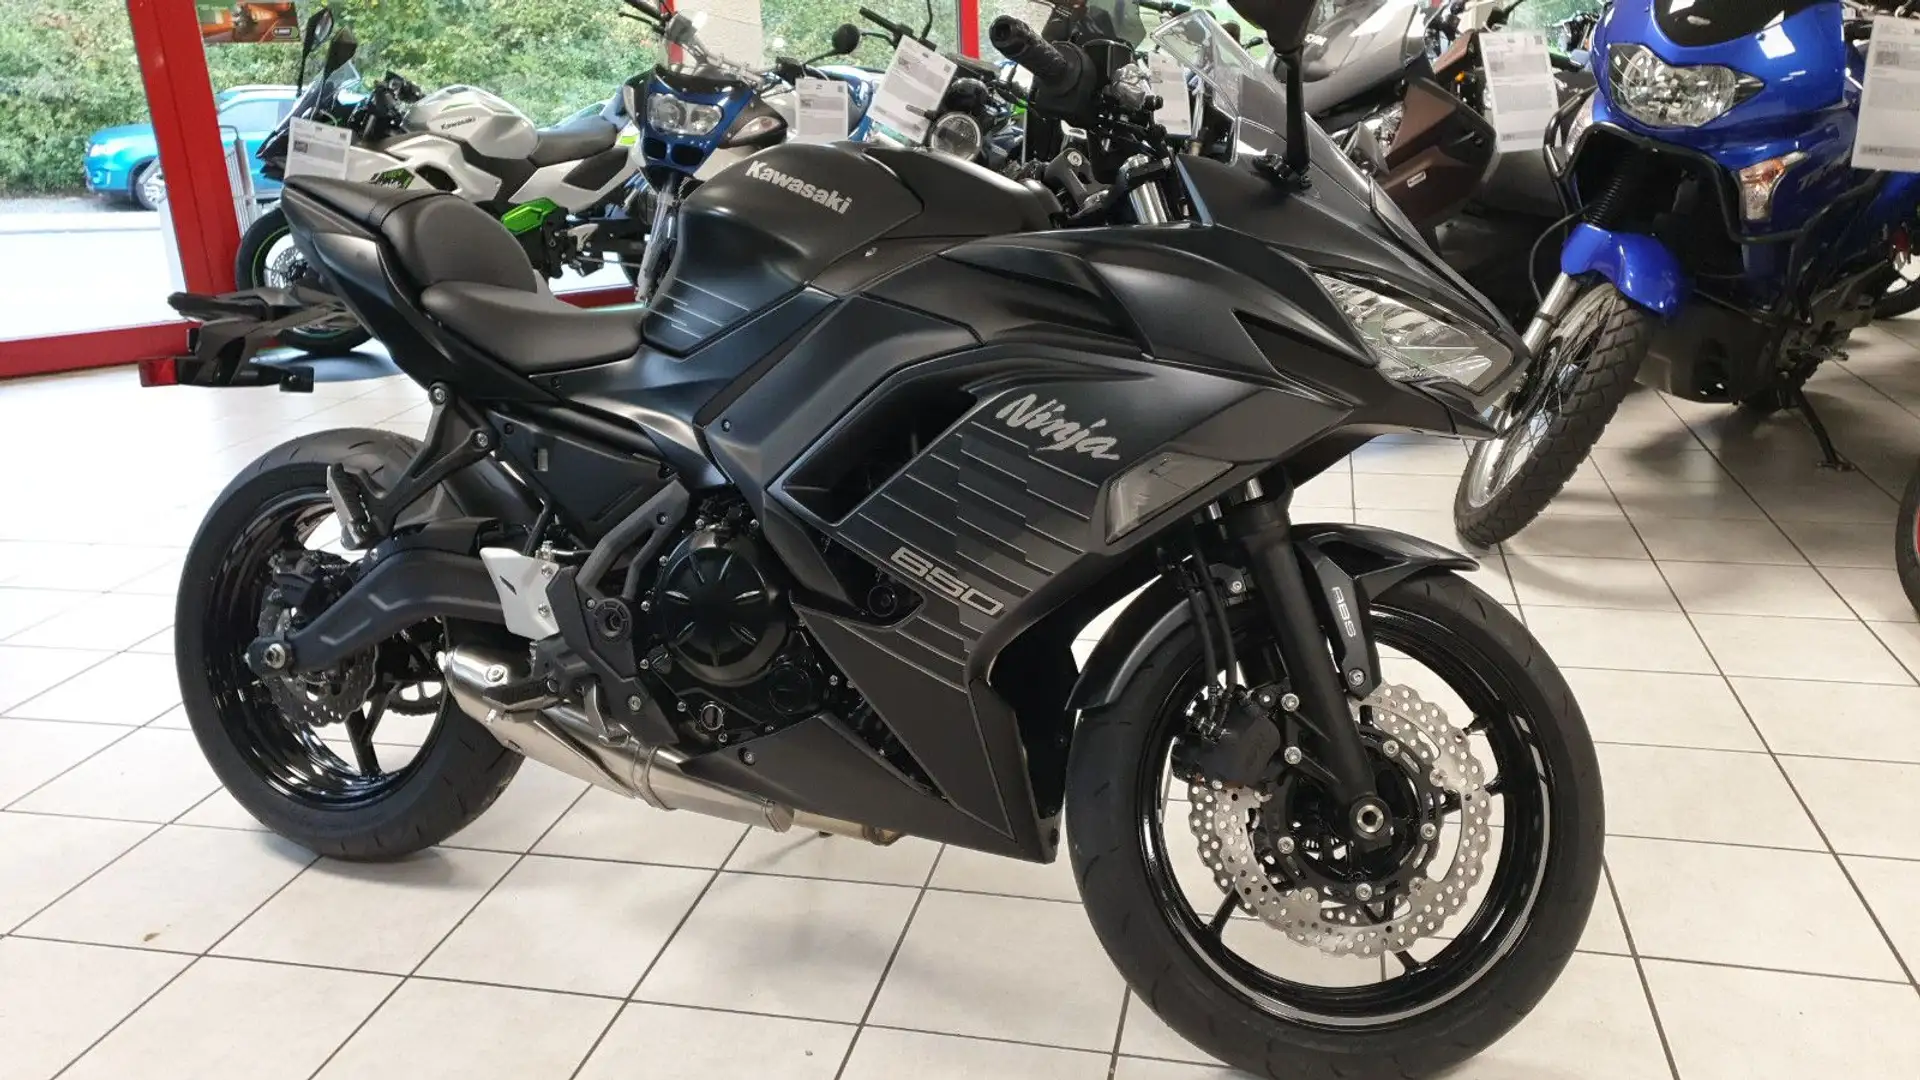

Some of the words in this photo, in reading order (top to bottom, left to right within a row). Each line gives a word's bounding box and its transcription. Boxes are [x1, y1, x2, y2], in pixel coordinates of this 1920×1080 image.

[745, 160, 853, 214] Kawasaki
[995, 393, 1120, 460] Ninja
[890, 546, 1005, 616] 650
[1331, 586, 1356, 638] ABS
